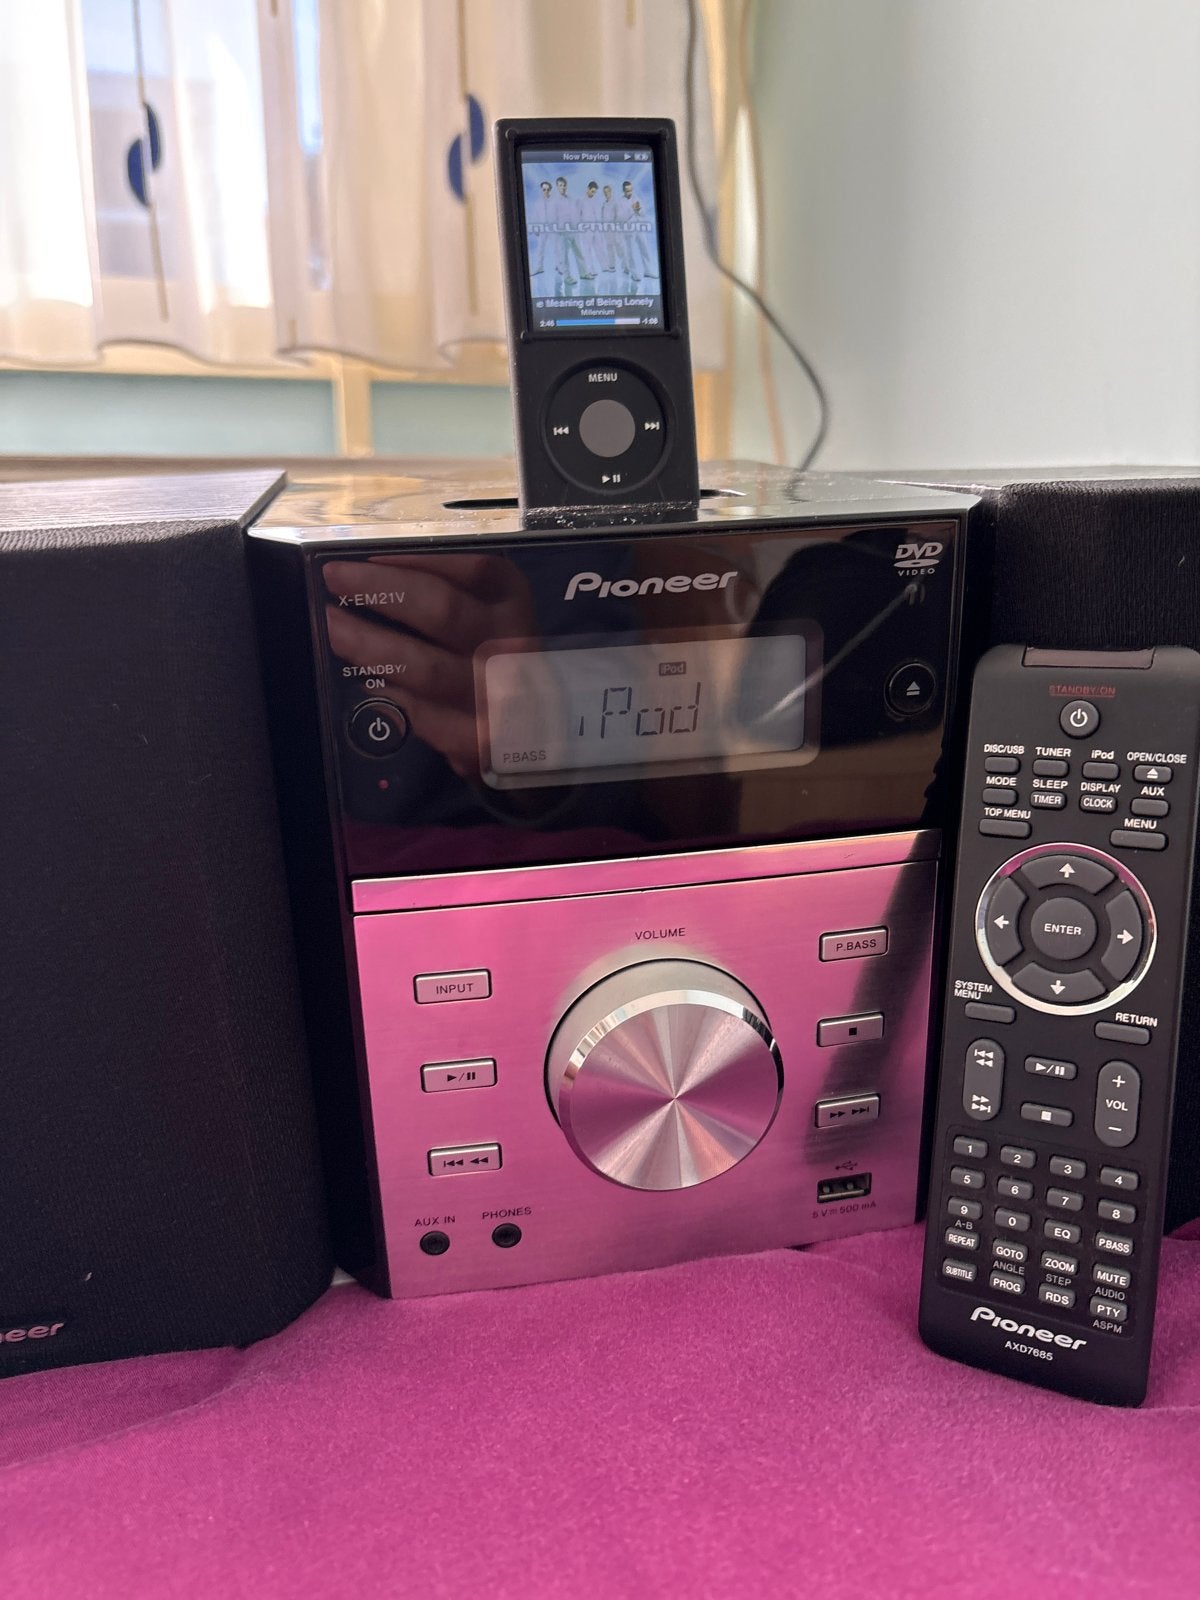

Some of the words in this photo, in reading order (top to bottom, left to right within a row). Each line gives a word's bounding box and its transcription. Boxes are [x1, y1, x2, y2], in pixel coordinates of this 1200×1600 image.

[563, 152, 580, 161] Now
[582, 152, 610, 162] Playing
[546, 299, 585, 309] Meaning
[586, 298, 595, 306] of
[596, 298, 623, 308] Being
[624, 297, 654, 307] Lonely
[588, 373, 618, 383] MENU
[895, 541, 943, 559] DVD
[898, 568, 936, 577] VIDEO
[564, 571, 738, 601] Pioneer
[339, 592, 406, 606] X-EM21V
[342, 664, 407, 678] STANDBY/
[660, 663, 685, 675] iPod
[366, 678, 386, 690] ON
[1049, 684, 1116, 696] STANDBY/ON
[578, 681, 701, 739] iPod
[984, 744, 1025, 754] DISC/USB
[1035, 746, 1072, 758] TUNER
[1091, 750, 1115, 760] iPod
[1126, 752, 1188, 764] OPEN/CLOSE
[986, 776, 1017, 786] MODE
[1032, 779, 1068, 790] SLEEP
[1080, 782, 1121, 794] DISPLAY
[1141, 786, 1165, 796] AUX
[1034, 794, 1062, 805] TIMER
[1083, 798, 1113, 808] CLOCK
[984, 807, 1002, 817] TOP
[1004, 808, 1032, 819] MENU
[1124, 818, 1158, 830] MENU
[634, 927, 686, 940] VOLUME
[1044, 923, 1082, 936] ENTER
[836, 938, 877, 952] P.BASS
[436, 982, 475, 994] INPUT
[955, 980, 993, 992] SYSTEM
[954, 989, 982, 1000] MENU
[1115, 1012, 1158, 1027] RETURN
[1106, 1099, 1128, 1112] VOL
[967, 1144, 973, 1154] 1
[1014, 1154, 1021, 1164] 2
[1064, 1164, 1072, 1174] 3
[964, 1175, 971, 1184] 5
[1115, 1175, 1123, 1185] 4
[1011, 1186, 1019, 1195] 6
[1062, 1196, 1070, 1206] 7
[482, 1206, 532, 1220] PHONES
[840, 1204, 859, 1214] 500
[960, 1205, 968, 1215] 9
[1112, 1209, 1120, 1219] 8
[414, 1216, 440, 1227] AUX
[444, 1216, 456, 1224] IN
[954, 1219, 973, 1230] A-B
[1008, 1216, 1016, 1226] 0
[948, 1233, 976, 1247] REPEAT
[1054, 1228, 1071, 1240] EQ
[1098, 1238, 1130, 1254] P.BASS
[996, 1246, 1024, 1260] GOTO
[992, 1260, 1025, 1276] ANGLE
[1044, 1258, 1075, 1273] ZOOM
[945, 1265, 973, 1280] SUBTITLE
[1096, 1270, 1127, 1286] MUTE
[993, 1278, 1021, 1292] PROG
[1046, 1274, 1072, 1287] STEP
[1045, 1291, 1070, 1305] RDS
[1094, 1286, 1126, 1301] AUDIO
[1096, 1304, 1121, 1318] PTY
[970, 1306, 1088, 1350] Pioneer
[1092, 1319, 1123, 1334] ASPM
[1004, 1340, 1054, 1361] AXD7685
